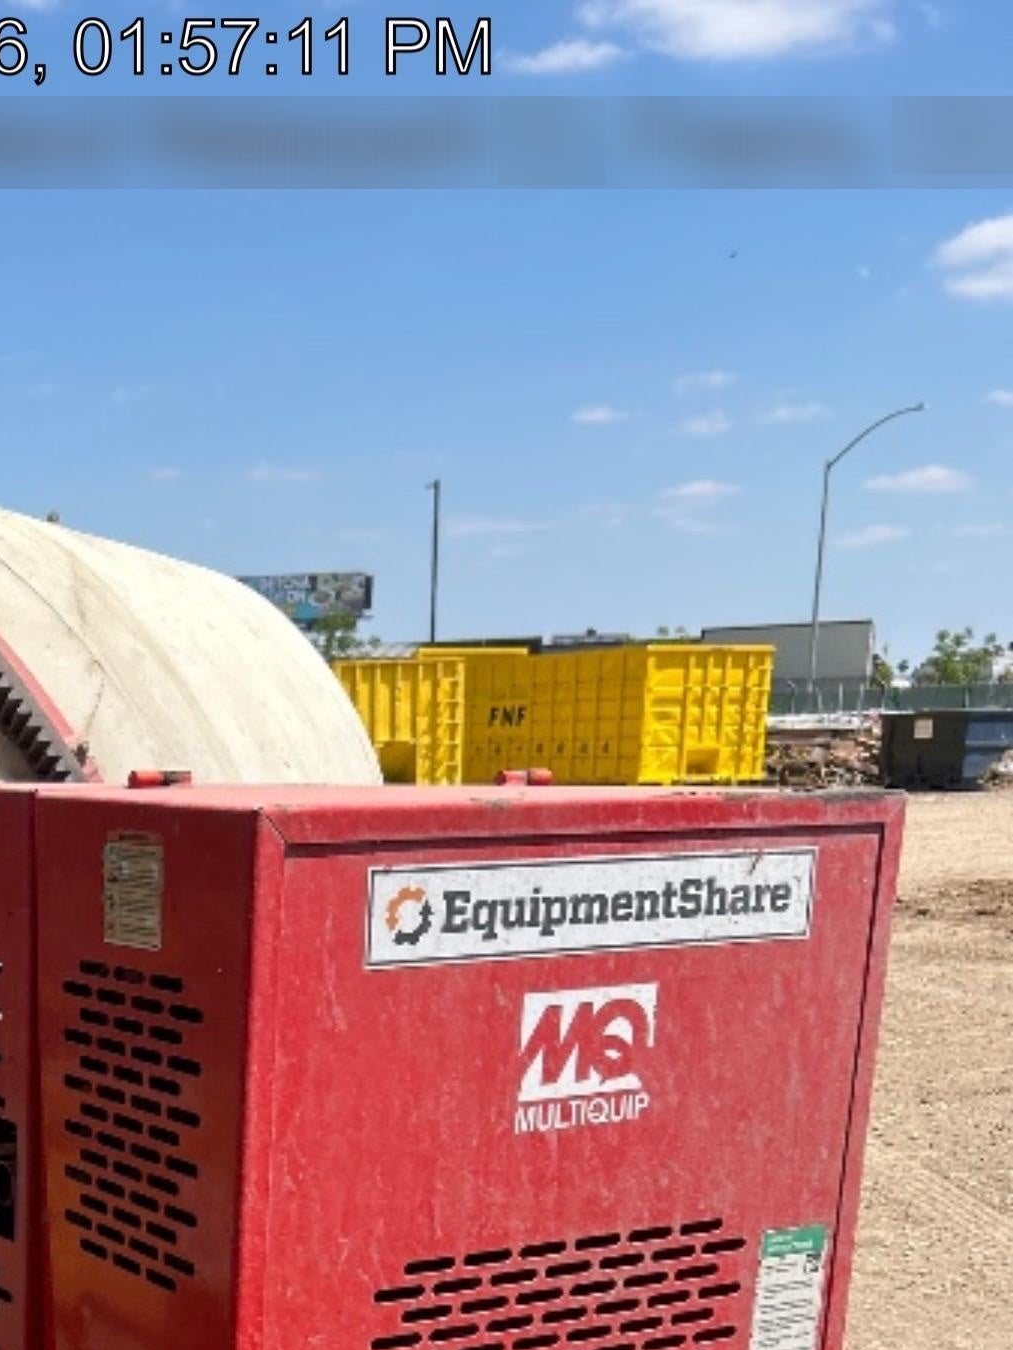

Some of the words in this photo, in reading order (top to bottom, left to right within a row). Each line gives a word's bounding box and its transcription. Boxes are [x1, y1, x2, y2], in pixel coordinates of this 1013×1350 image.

[488, 704, 527, 728] FNF
[441, 876, 792, 942] EquipmentShare
[518, 993, 656, 1090] MQ
[515, 1092, 649, 1135] MULTIQUIP
